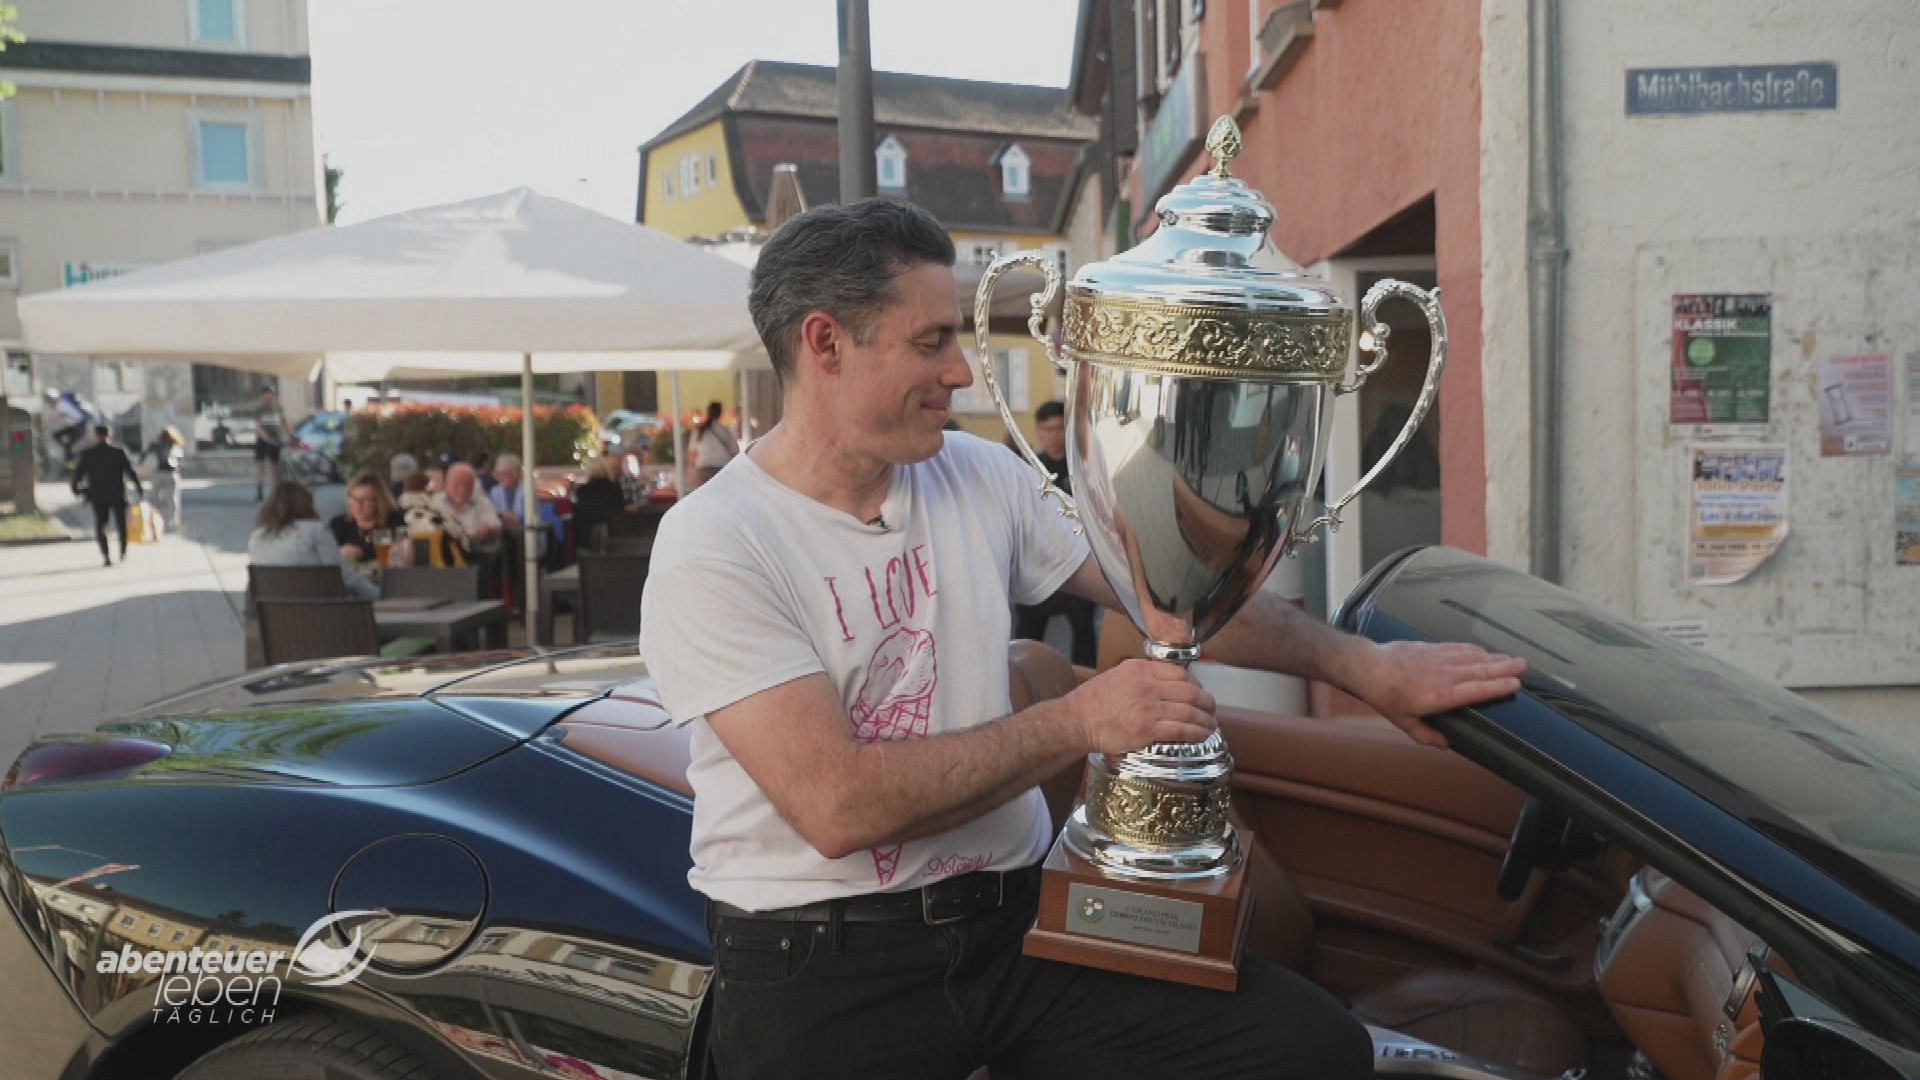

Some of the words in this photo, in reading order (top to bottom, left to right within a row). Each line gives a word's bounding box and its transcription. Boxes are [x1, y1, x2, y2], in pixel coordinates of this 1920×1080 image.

[1636, 69, 1825, 106] Mühlbachstraße
[1674, 319, 1737, 330] KLASSIK
[823, 576, 855, 643] I
[864, 544, 938, 630] LOVE
